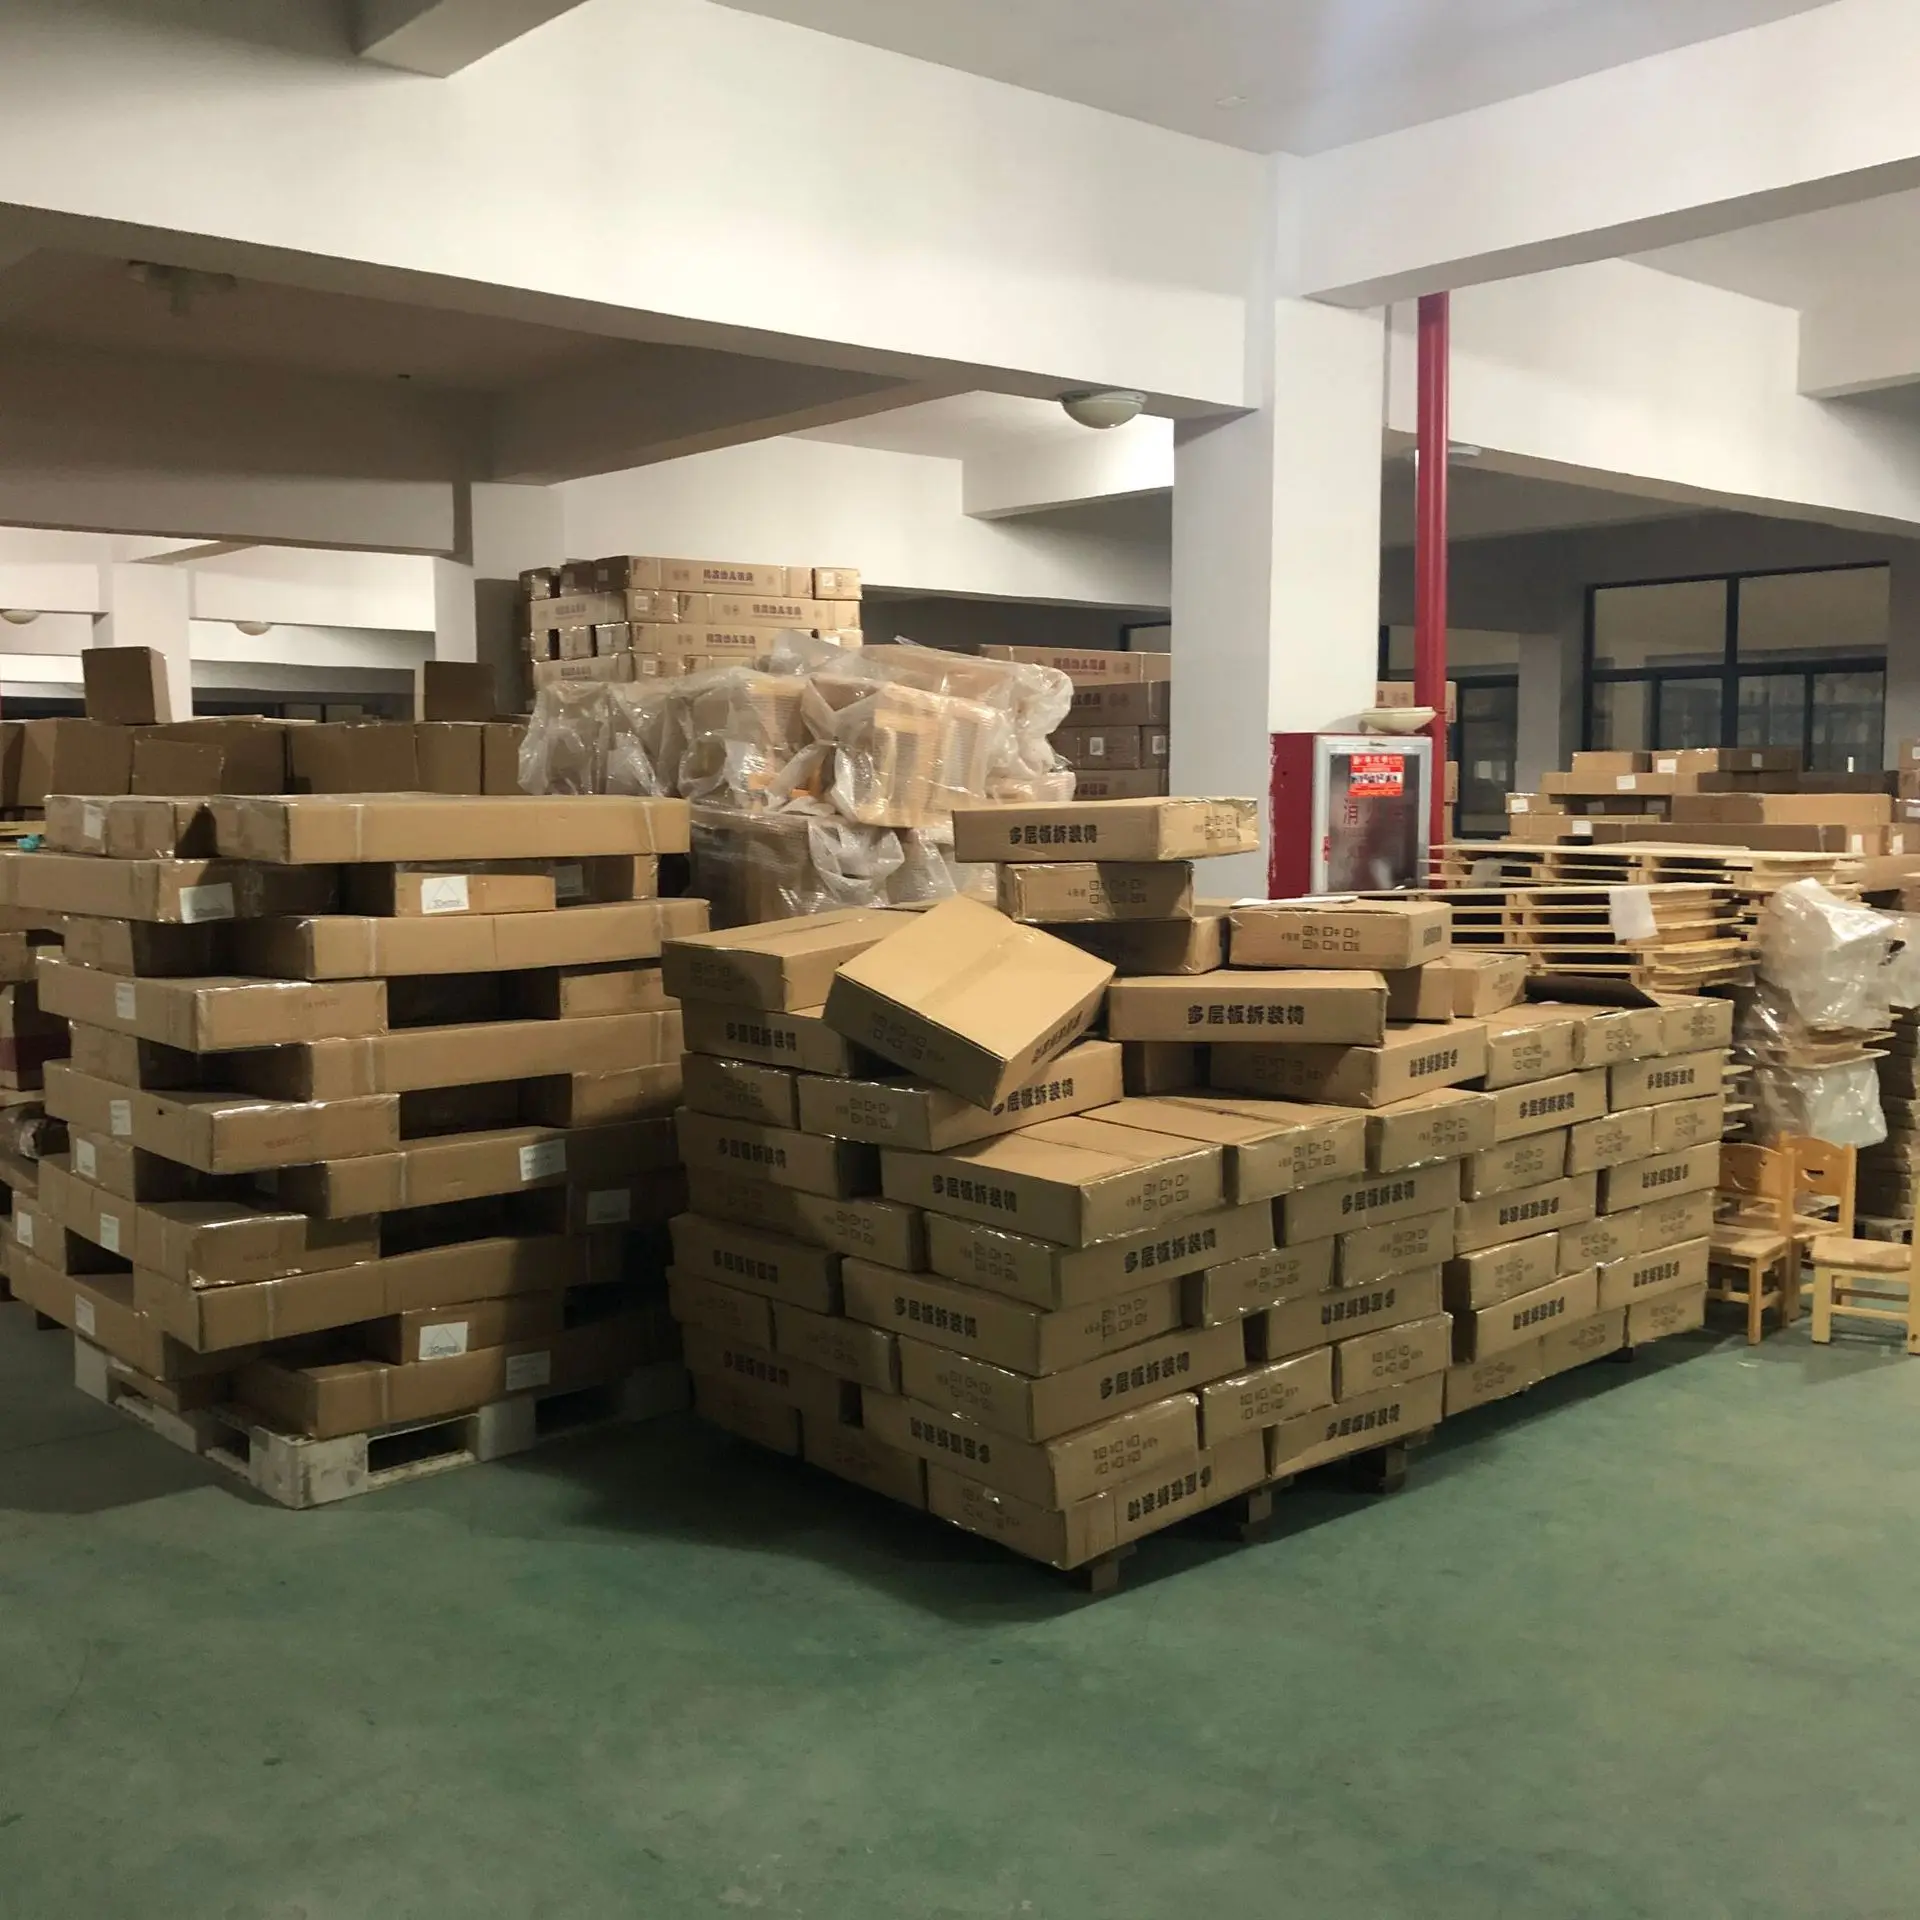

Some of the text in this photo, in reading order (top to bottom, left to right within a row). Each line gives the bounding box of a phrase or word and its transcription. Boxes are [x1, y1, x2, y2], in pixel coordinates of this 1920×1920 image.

[1188, 1005, 1305, 1025] 多层板拆装椅
[932, 1174, 1017, 1213] 多层板拆装椅
[1124, 1228, 1216, 1273] 多层板拆装椅
[1100, 1351, 1190, 1399] 多层板拆装椅
